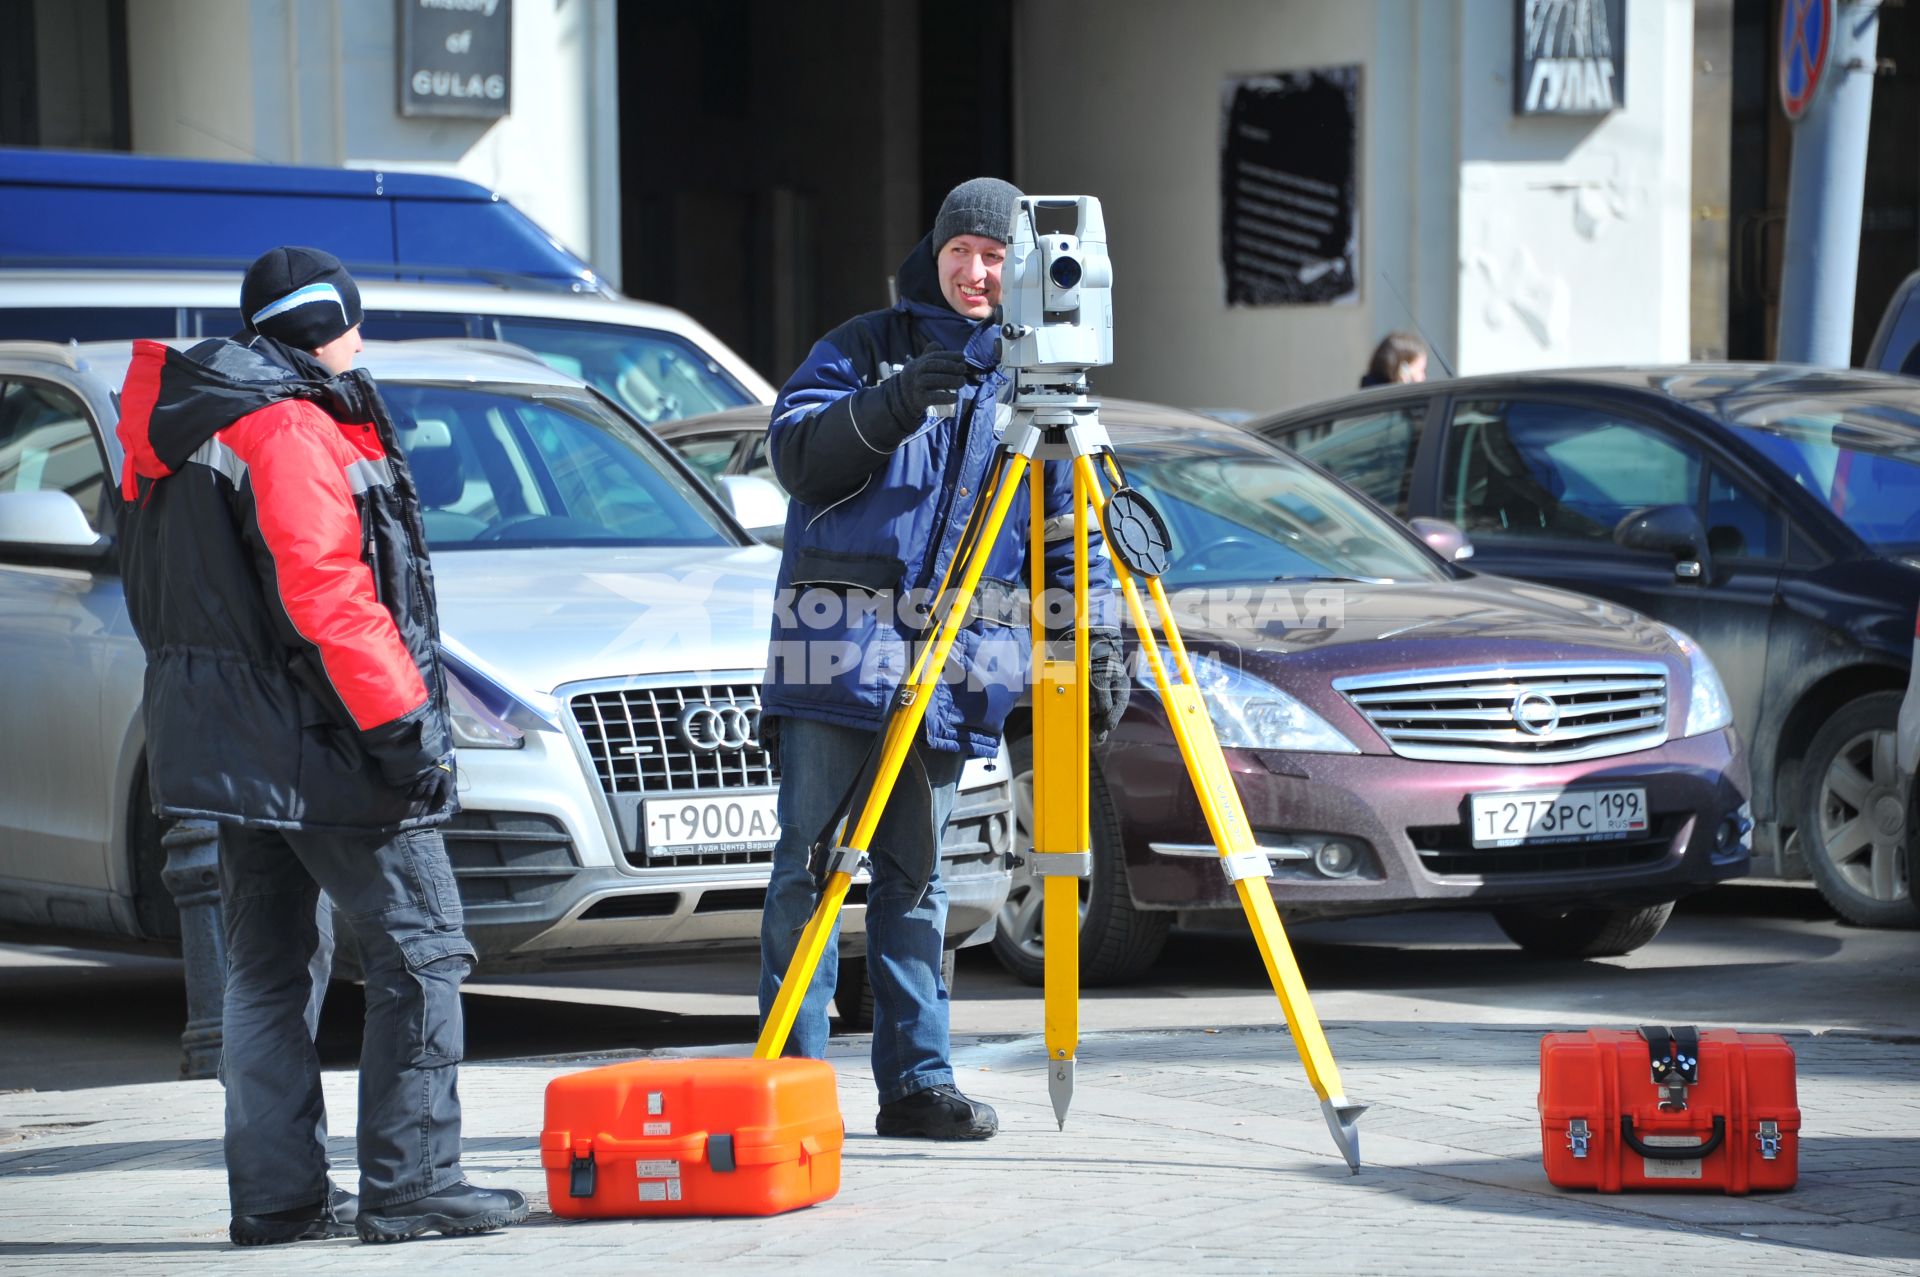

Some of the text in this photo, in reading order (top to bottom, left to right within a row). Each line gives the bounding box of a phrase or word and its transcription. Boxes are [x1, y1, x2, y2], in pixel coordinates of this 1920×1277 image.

[445, 29, 472, 54] of
[412, 69, 505, 99] GULAG
[1526, 57, 1615, 111] ГУЛАГ
[1600, 792, 1639, 818] 199
[1608, 820, 1628, 829] RUS
[698, 844, 718, 853] Ауди
[720, 842, 746, 852] Центр
